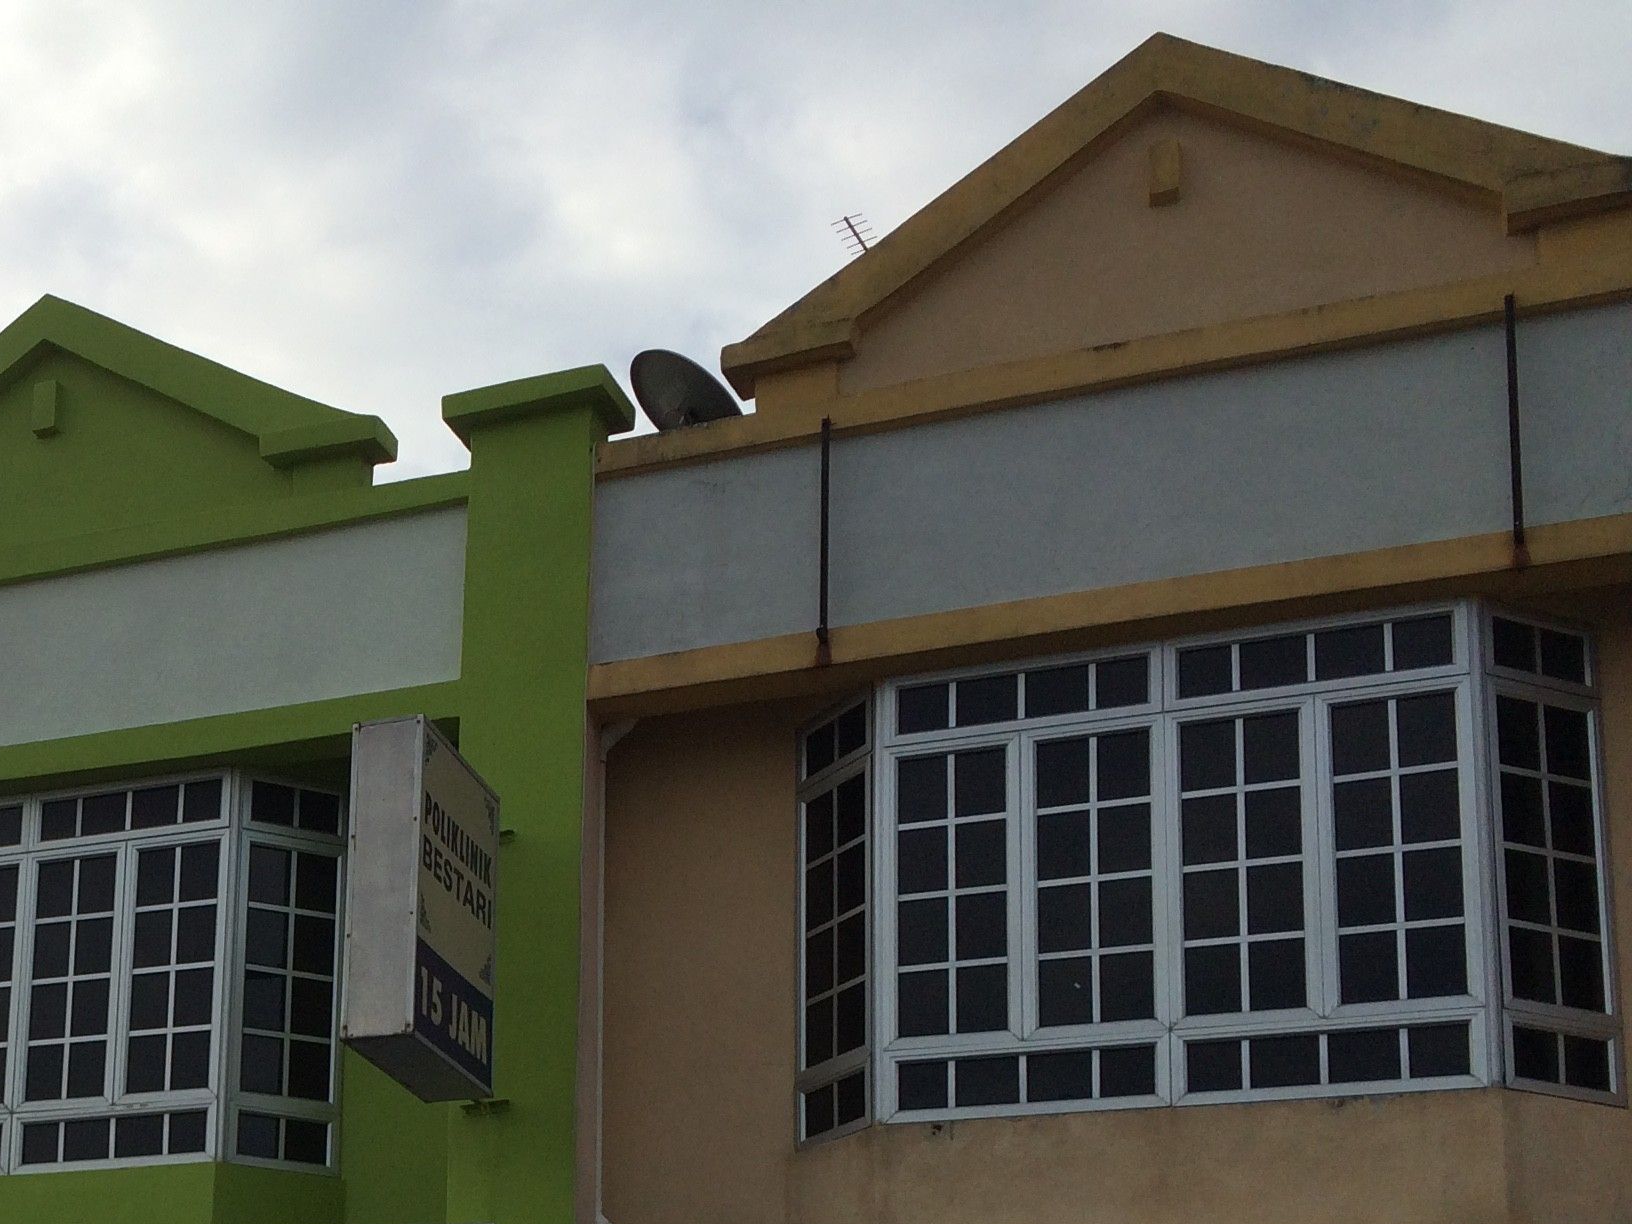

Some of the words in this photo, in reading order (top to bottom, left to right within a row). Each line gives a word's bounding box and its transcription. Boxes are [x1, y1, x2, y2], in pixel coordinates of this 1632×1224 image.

[422, 834, 492, 930] BESTARI
[424, 790, 492, 889] POLIKLINIK
[420, 966, 443, 1027] 15
[448, 994, 487, 1065] JAM
